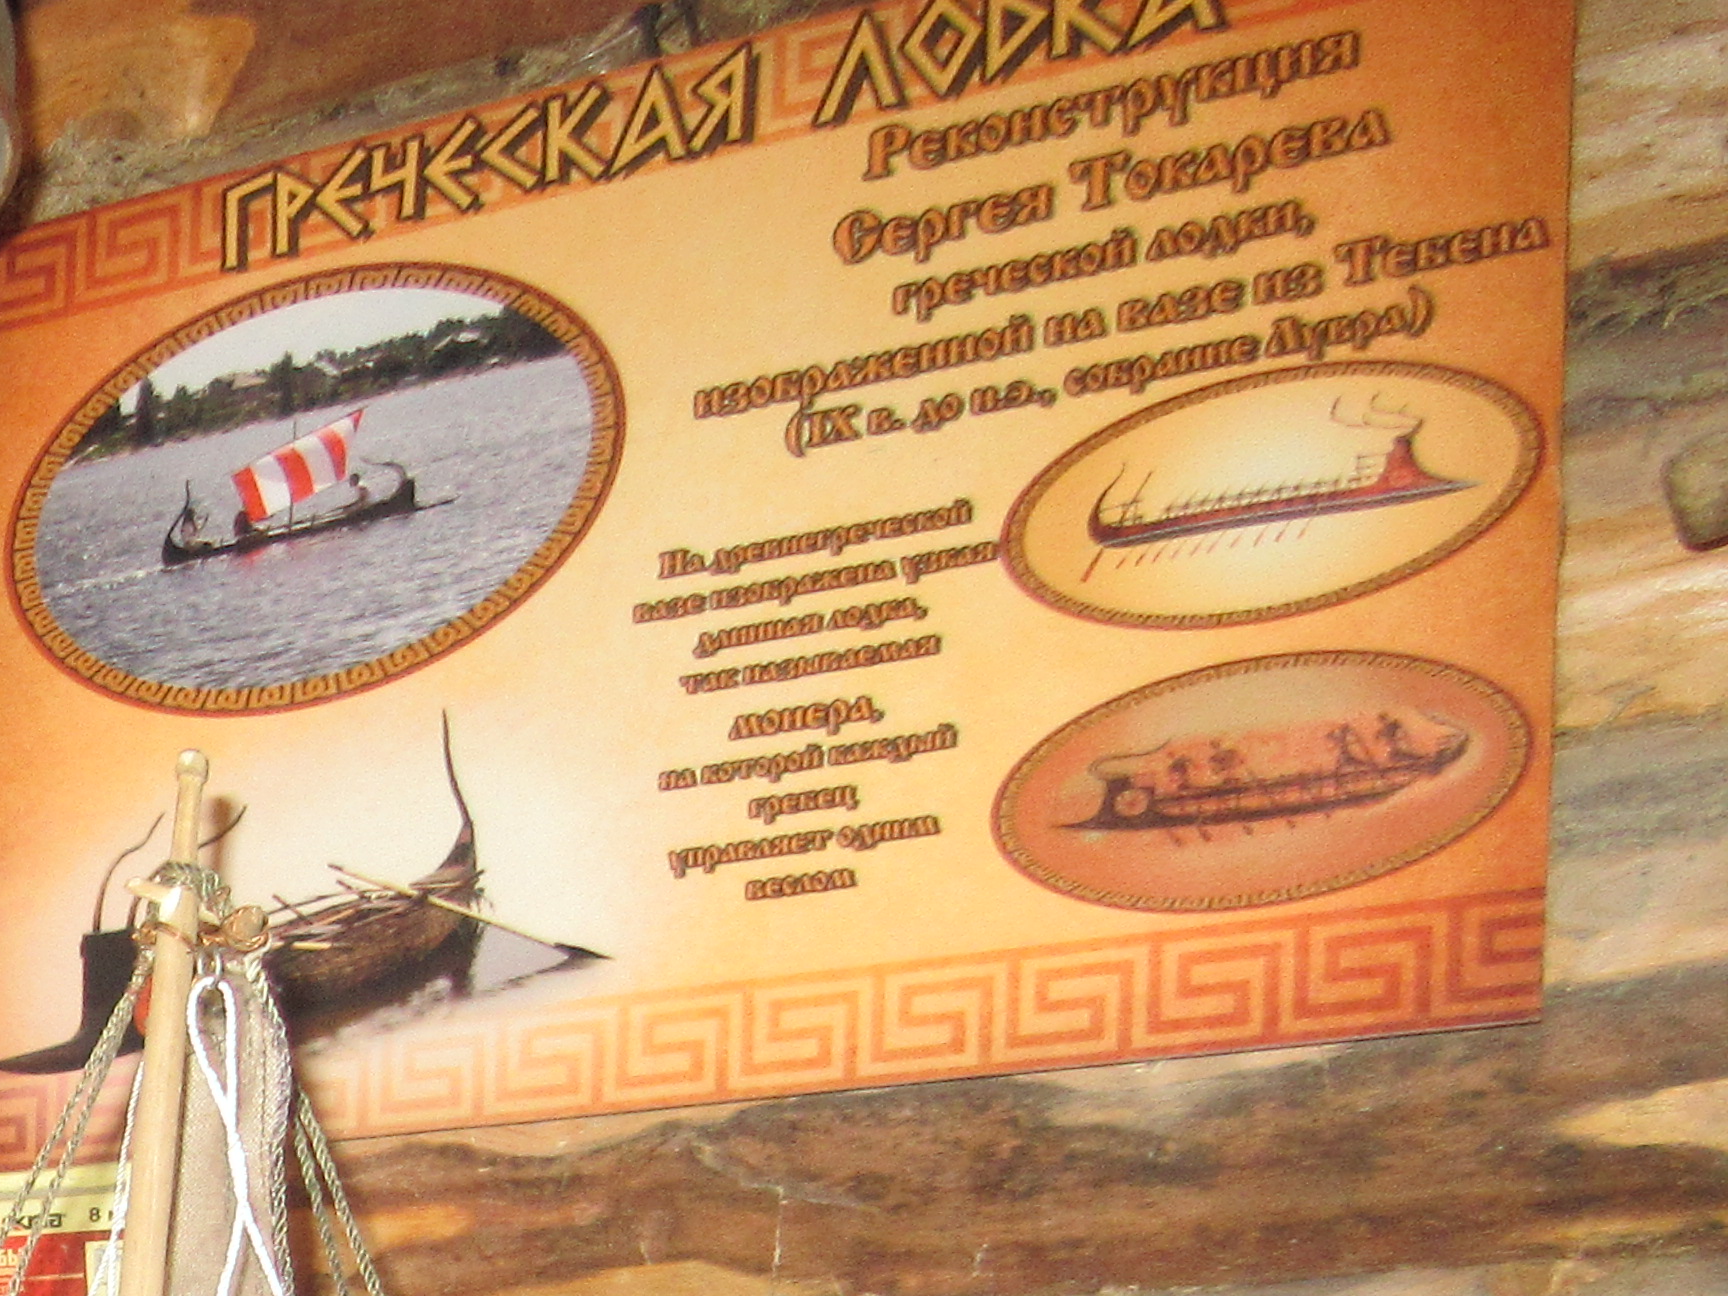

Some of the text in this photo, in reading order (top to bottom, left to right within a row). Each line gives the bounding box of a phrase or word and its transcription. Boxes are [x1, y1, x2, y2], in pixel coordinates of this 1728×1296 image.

[862, 30, 1360, 181] Реконструкция
[222, 42, 758, 272] ГРЕЧЕСКАЯ
[833, 108, 1392, 265] Сергея Токарева
[892, 200, 1316, 323] греческой лодки,
[694, 315, 1034, 419] изображенной
[1044, 307, 1108, 347] на
[1117, 280, 1245, 333] вазе
[1252, 261, 1325, 305] из
[910, 392, 966, 433] до
[1063, 335, 1261, 398] собрание
[1264, 285, 1434, 360] Лувра)
[658, 549, 706, 579] На
[679, 668, 741, 695] так
[658, 722, 959, 791] на которой каждый
[669, 815, 941, 878] управляет одним
[745, 867, 858, 901] веслом
[89, 1207, 100, 1222] 8
